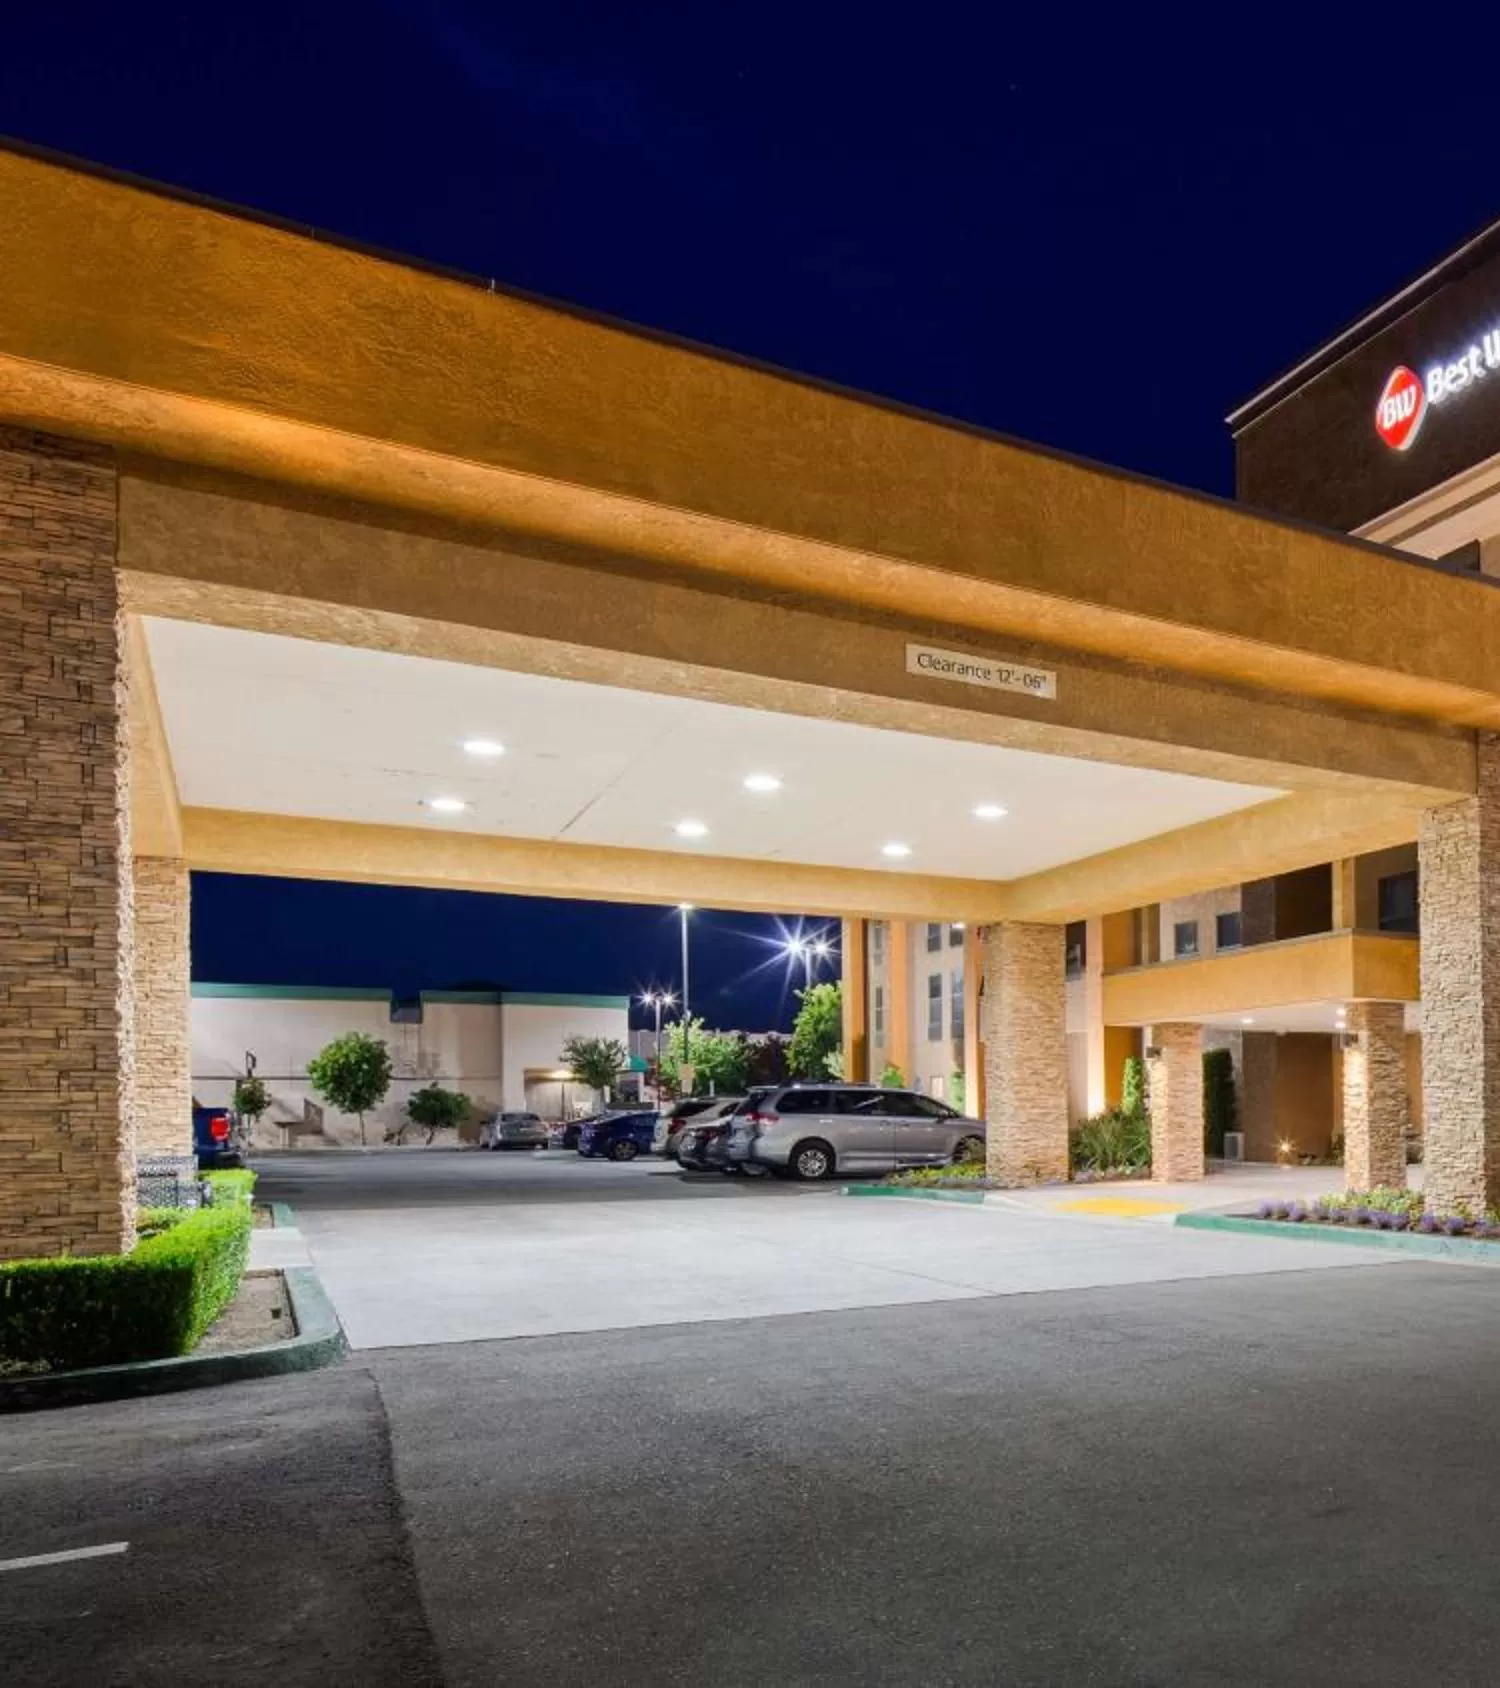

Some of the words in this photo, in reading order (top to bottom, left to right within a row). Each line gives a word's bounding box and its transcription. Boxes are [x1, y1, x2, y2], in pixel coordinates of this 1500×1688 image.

[1425, 345, 1486, 404] Best
[1380, 385, 1417, 430] BW
[916, 652, 991, 681] Clearance
